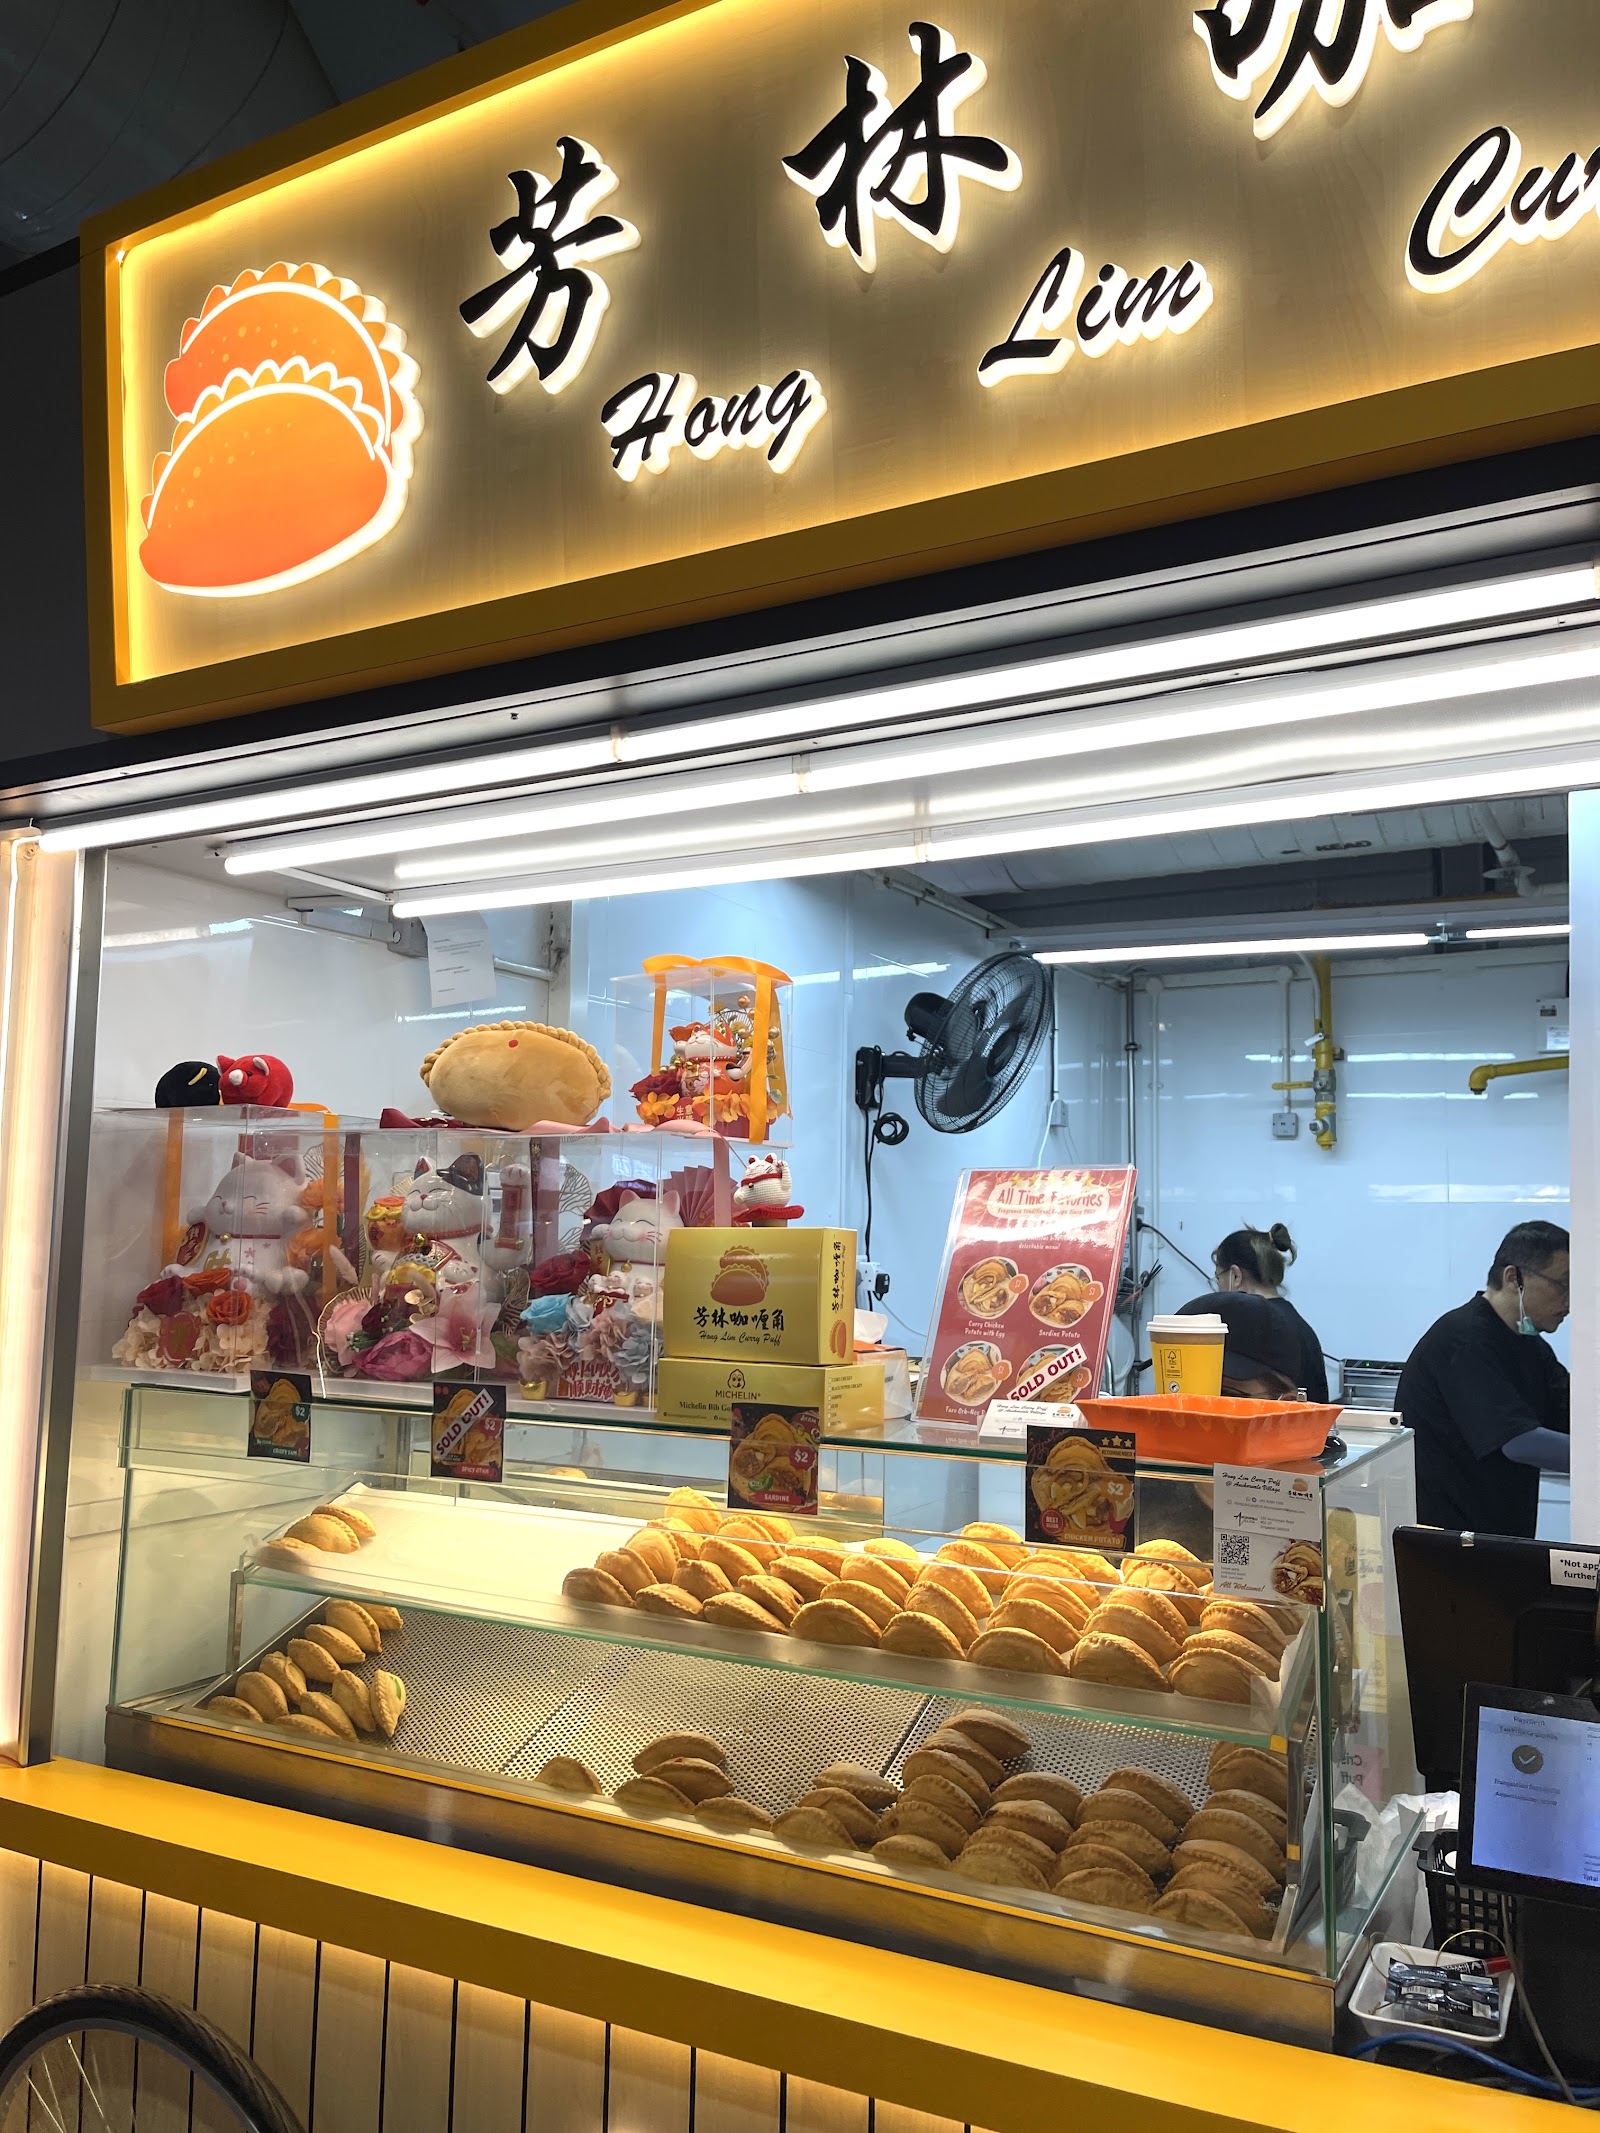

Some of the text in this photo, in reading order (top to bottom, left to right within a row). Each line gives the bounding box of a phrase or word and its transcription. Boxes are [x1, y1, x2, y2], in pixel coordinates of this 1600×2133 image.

[600, 369, 816, 471] Hong
[978, 246, 1203, 373] Lim
[997, 1188, 1014, 1204] All
[1018, 1190, 1045, 1205] Time
[694, 1306, 785, 1332] 芳林咖喱角
[968, 1320, 1004, 1329] Curry Chicken
[699, 1330, 782, 1347] Hong Lim Curry Puff
[996, 1330, 1005, 1338] Egg
[1062, 1330, 1080, 1338] Potato
[1011, 1348, 1082, 1401] SOLD OUT!
[295, 1405, 305, 1416] $2
[680, 1401, 707, 1410] Michelin
[708, 1403, 720, 1411] Bib
[436, 1423, 462, 1455] SOLD
[461, 1393, 489, 1425] OUT!
[484, 1418, 496, 1431] $2
[794, 1448, 809, 1464] $2
[1250, 1475, 1267, 1485] Curry
[1268, 1477, 1281, 1488] Puff
[1107, 1480, 1125, 1496] $2
[1262, 1484, 1281, 1494] Village
[764, 1493, 790, 1502] SARDINE
[1064, 1533, 1121, 1545] CHICKEN POTATO
[1564, 1570, 1596, 1580] further
[1219, 1581, 1266, 1592] All Welcome!
